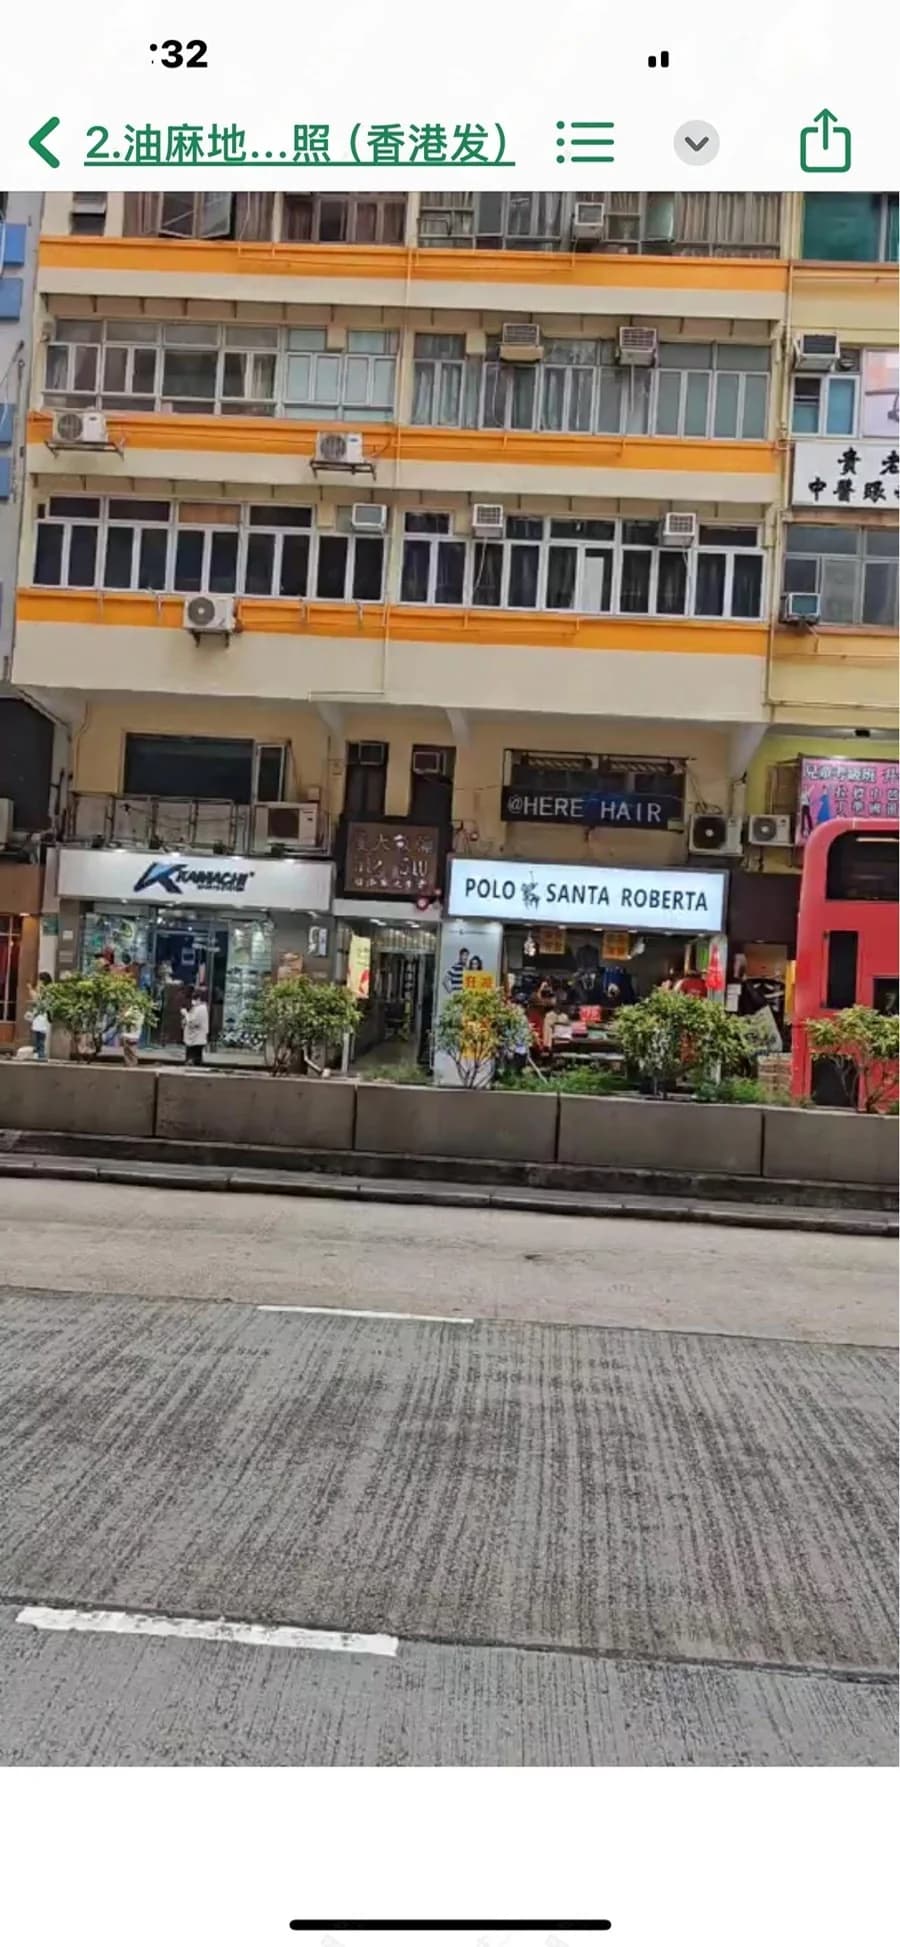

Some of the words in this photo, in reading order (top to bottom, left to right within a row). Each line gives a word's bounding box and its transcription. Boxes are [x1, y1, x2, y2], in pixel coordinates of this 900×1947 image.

[807, 476, 898, 503] 中醫眼
[507, 795, 583, 819] @HERE
[600, 800, 662, 823] HAIR
[464, 877, 517, 900] POLO
[545, 882, 611, 906] SANTA
[620, 887, 709, 911] ROBERTA
